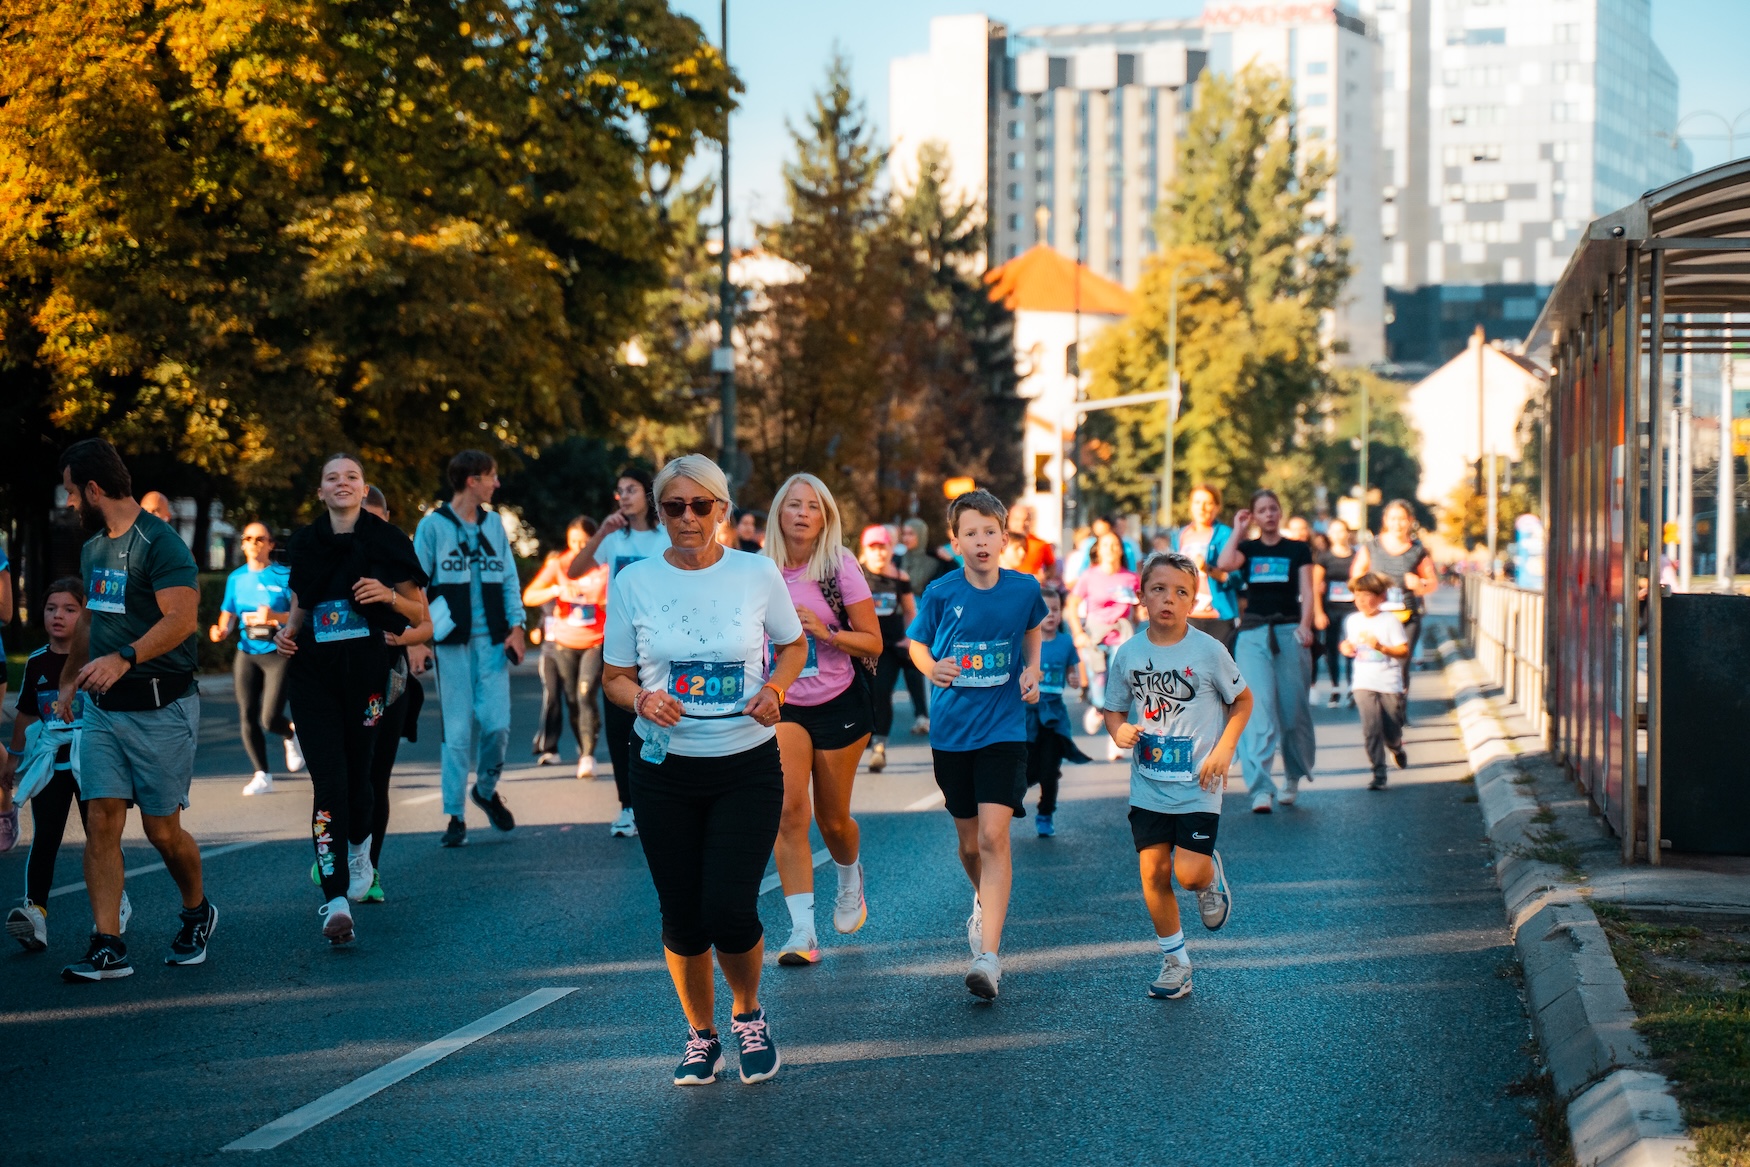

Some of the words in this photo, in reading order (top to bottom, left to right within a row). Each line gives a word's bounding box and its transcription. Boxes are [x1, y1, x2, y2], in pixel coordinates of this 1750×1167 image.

[95, 580, 119, 596] 6899
[961, 652, 1005, 671] 6883
[675, 673, 737, 697] 6208
[43, 700, 80, 715] 693
[1143, 745, 1181, 764] 6961
